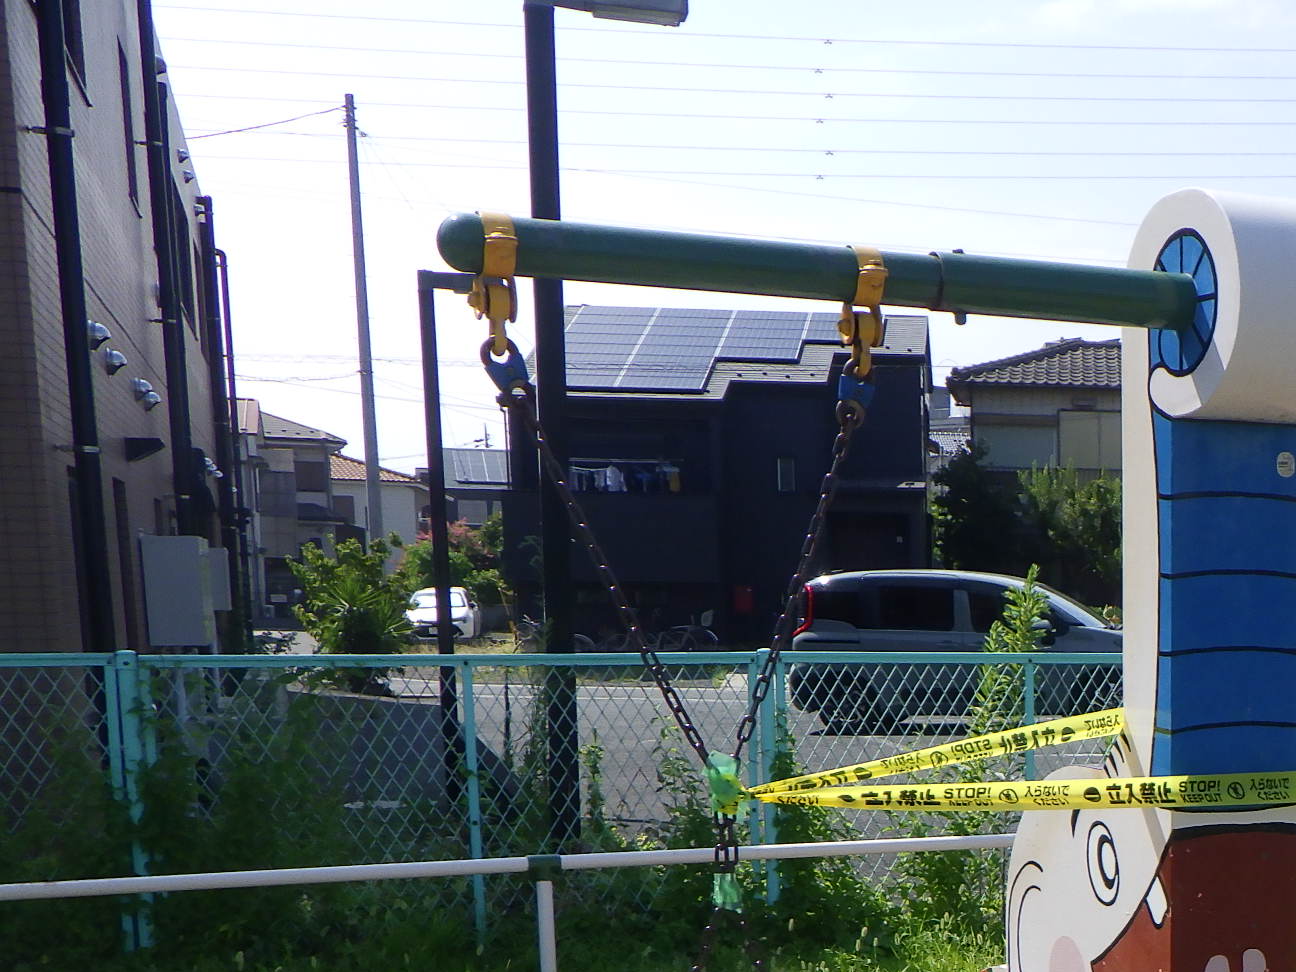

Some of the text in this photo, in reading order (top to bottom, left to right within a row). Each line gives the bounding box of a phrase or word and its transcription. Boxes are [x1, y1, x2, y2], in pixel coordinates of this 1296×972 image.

[1178, 780, 1221, 793] STOP!
[1250, 778, 1290, 790] 入らないで
[944, 787, 992, 799] STOP!
[1025, 785, 1070, 797] 入らないで
[1106, 782, 1176, 804] 立入禁止
[1257, 790, 1290, 801] ください
